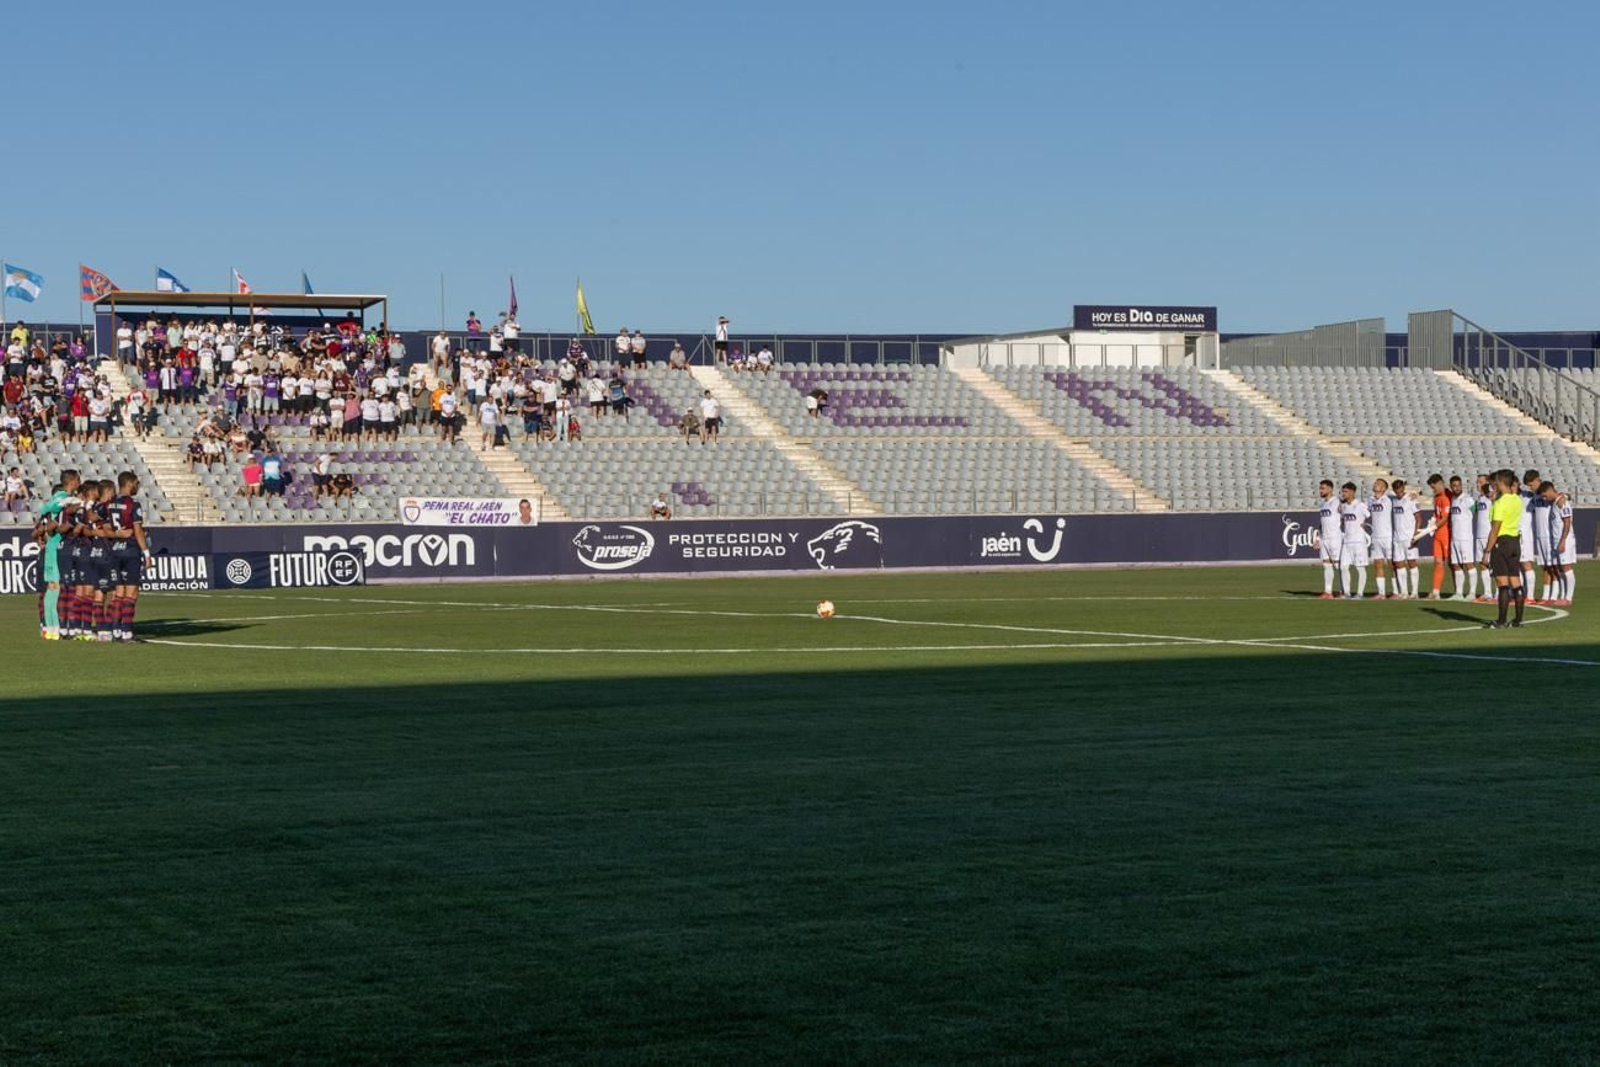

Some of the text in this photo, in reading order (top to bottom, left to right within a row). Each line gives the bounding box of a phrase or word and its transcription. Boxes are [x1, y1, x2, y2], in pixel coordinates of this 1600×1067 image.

[1092, 312, 1112, 322] HOY
[1114, 312, 1127, 322] ES
[1156, 313, 1169, 323] DE
[1171, 313, 1205, 323] GANAR
[450, 501, 475, 511] REAL
[788, 532, 799, 543] Y
[592, 541, 652, 562] proseja
[682, 545, 787, 558] SEGURIDAD
